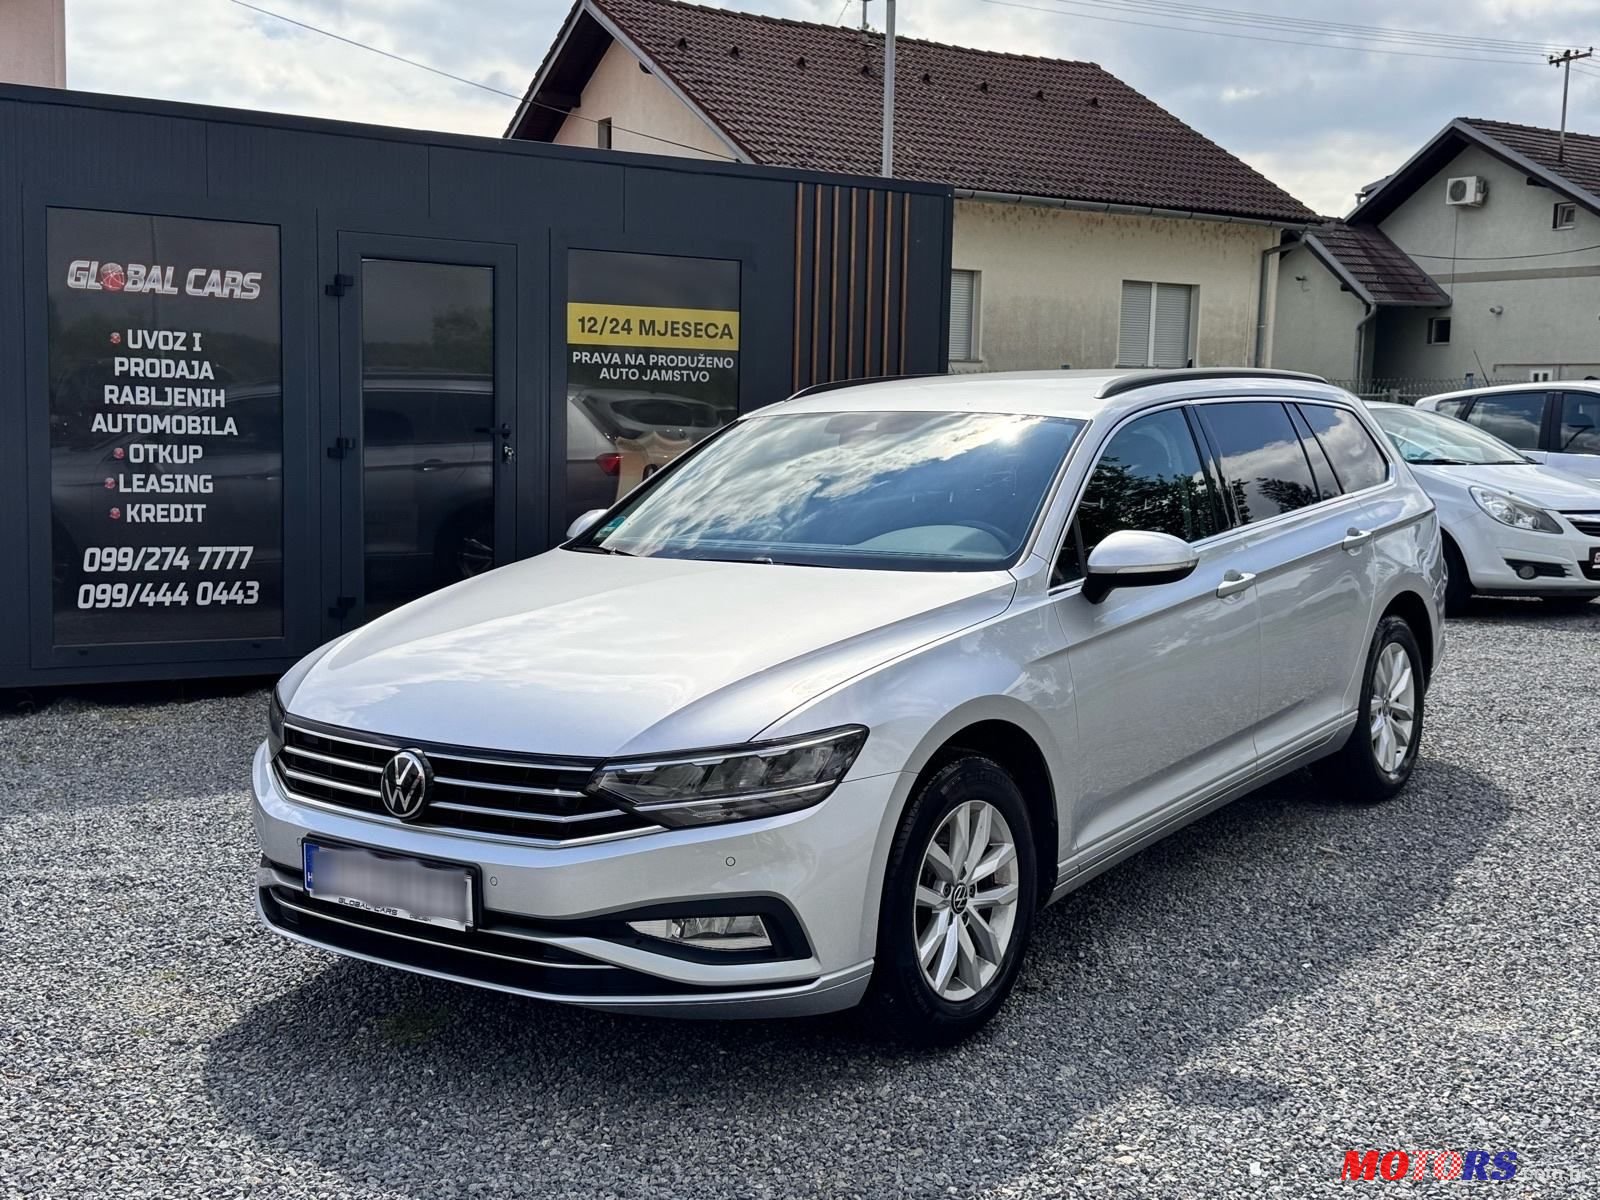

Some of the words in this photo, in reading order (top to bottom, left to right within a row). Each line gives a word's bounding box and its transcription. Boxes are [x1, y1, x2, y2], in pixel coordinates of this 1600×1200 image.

[67, 260, 178, 294] GLOBAL
[185, 267, 262, 300] CARS
[578, 316, 633, 336] 12/24
[639, 319, 734, 340] MJESECA
[127, 329, 187, 351] UVOZ
[193, 333, 202, 351] I
[114, 357, 214, 380] PRODAJA
[572, 351, 621, 365] PRAVA
[625, 354, 646, 366] NA
[650, 354, 734, 369] PRODUŽENO
[600, 367, 640, 380] AUTO
[642, 369, 710, 383] JAMSTVO
[104, 385, 226, 408] RABLJENIH
[91, 413, 238, 436] AUTOMOBILA
[129, 443, 203, 464] OTKUP
[119, 474, 213, 493] LEASING
[126, 503, 206, 523] KREDIT
[83, 547, 190, 572] 099/274
[198, 546, 254, 570] 7777
[77, 582, 189, 609] 099/444
[196, 581, 260, 606] 0443
[338, 897, 371, 911] GLOBAL
[373, 905, 398, 916] CARS
